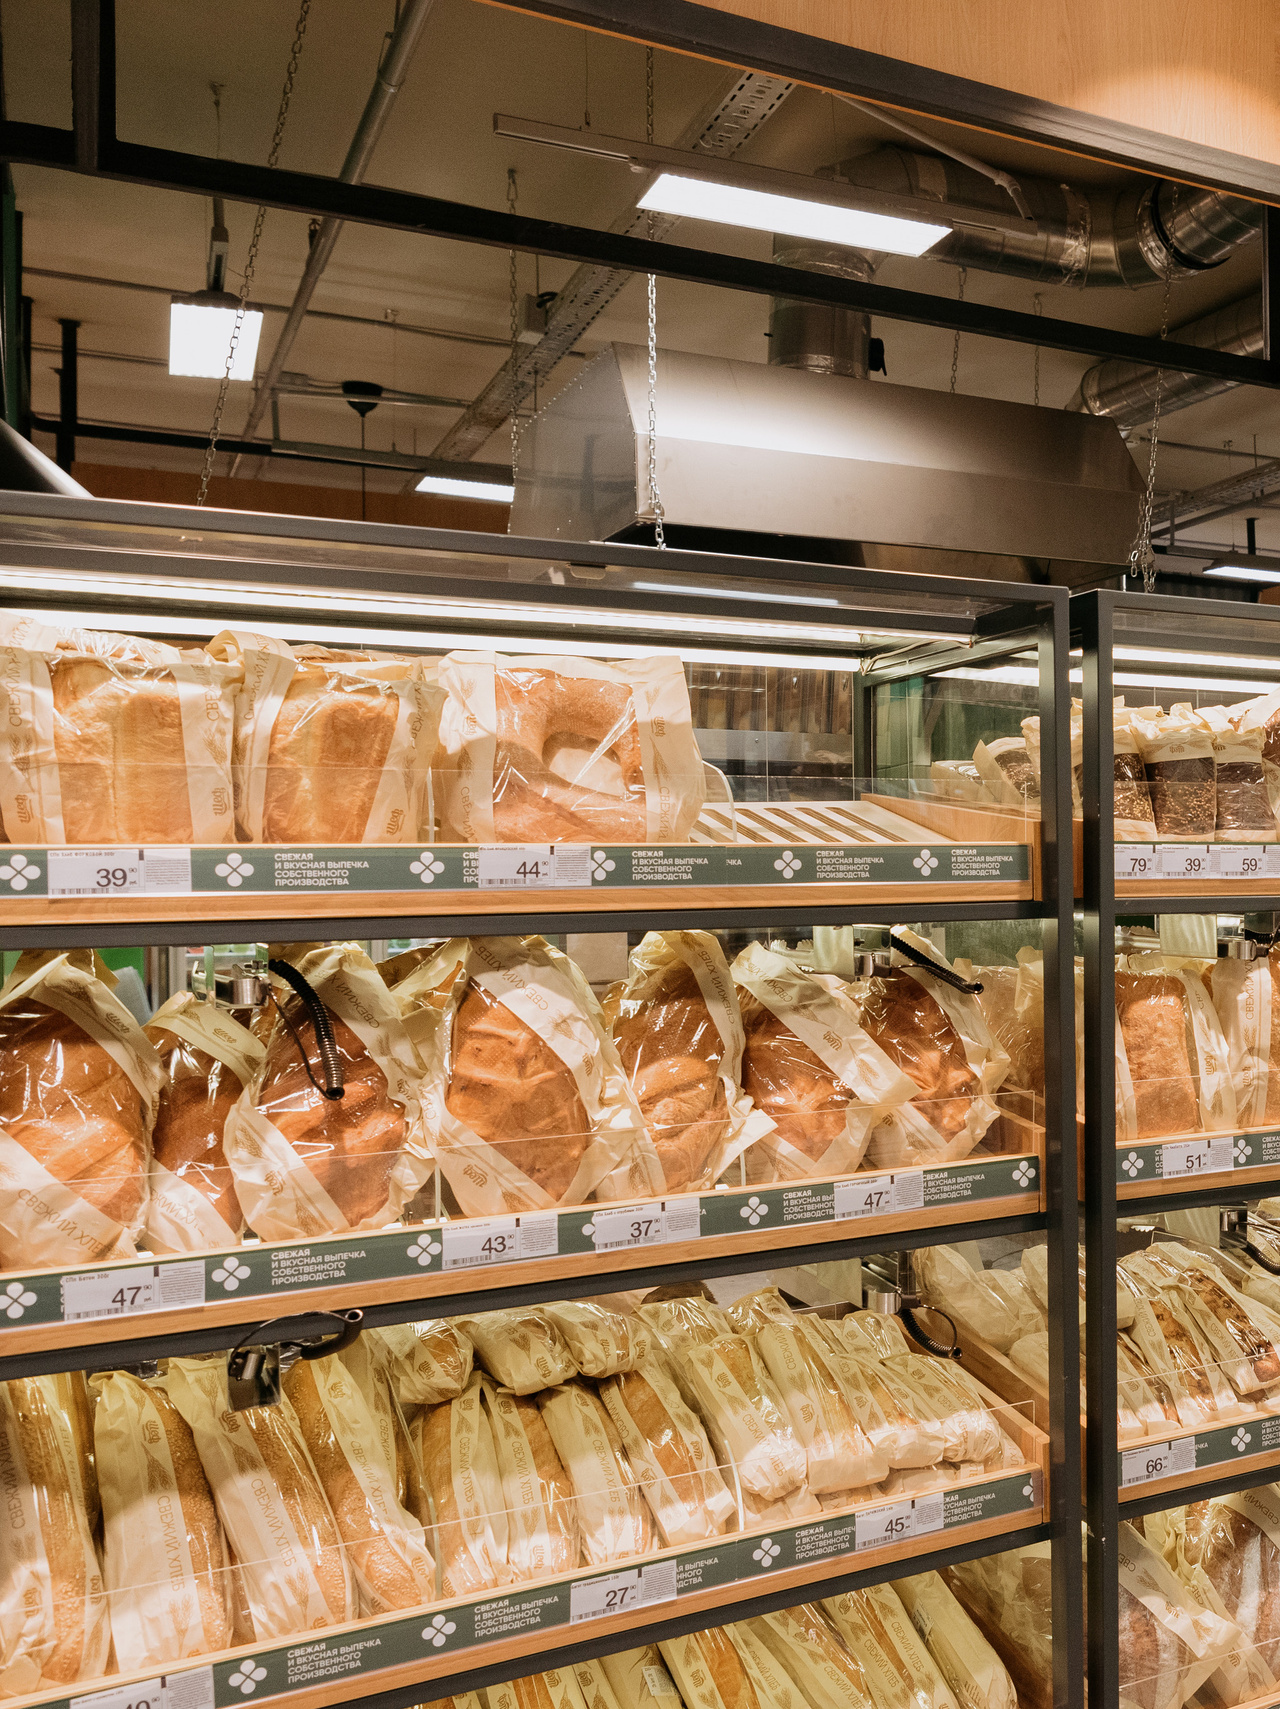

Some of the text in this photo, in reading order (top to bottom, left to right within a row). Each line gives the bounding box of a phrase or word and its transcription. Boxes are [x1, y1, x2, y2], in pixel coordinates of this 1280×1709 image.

[274, 853, 313, 861] СВЕЖАЯ
[1130, 858, 1147, 872] 79
[1185, 858, 1201, 872] 39
[1242, 858, 1258, 872] 59
[96, 868, 127, 887] 39
[274, 870, 349, 878] СОБСТВЕННОГО
[516, 861, 540, 878] 44
[274, 878, 349, 886] ПРОИЗВОДСТВА
[474, 945, 505, 971] ХЛЕБ
[1186, 1154, 1201, 1169] 51
[864, 1191, 884, 1208] 47
[18, 1188, 78, 1237] СВЕЖИЙ
[630, 1219, 654, 1238] 37
[271, 1248, 310, 1260] СВЕЖАЯ
[481, 1235, 506, 1254] 43
[271, 1250, 366, 1268] И ВКУСНАЯ ВЫПЕЧКА
[271, 1261, 346, 1277] СОБСТВЕННОГО
[271, 1269, 346, 1285] ПРОИЗВОДСТВА
[111, 1286, 142, 1307] 47
[351, 1440, 380, 1485] СВЕЖИЙ
[592, 1439, 619, 1503] СВЕЖИЙ ХЛЕБ
[1146, 1458, 1163, 1474] 66
[512, 1441, 534, 1505] СВЕЖИЙ ХЛЕБ
[461, 1475, 473, 1504] ХЛЕБ
[250, 1478, 297, 1567] СВЕЖИЙ ХЛЕБ
[884, 1516, 905, 1534] 45
[157, 1495, 186, 1592] СВЕЖИЙ ХЛЕБ
[474, 1598, 509, 1613] СВЕЖАЯ
[605, 1586, 630, 1607] 27
[474, 1594, 559, 1621] И ВКУСНАЯ ВЫПЕЧКА
[474, 1606, 541, 1629] СОБСТВЕННОГО
[474, 1614, 541, 1637] ПРОИЗВОДСТВА
[287, 1642, 326, 1658] СВЕЖАЯ
[287, 1637, 382, 1667] И ВКУСНАЯ ВЫПЕЧКА
[891, 1621, 924, 1672] СВЕЖИЙ ХЛЕБ
[287, 1650, 361, 1675] СОБСТВЕННОГО
[287, 1658, 361, 1684] ПРОИЗВОДСТВА
[864, 1639, 899, 1688] СВЕЖИЙ ХЛЕБ
[823, 1665, 850, 1694] СВЕЖИЙ
